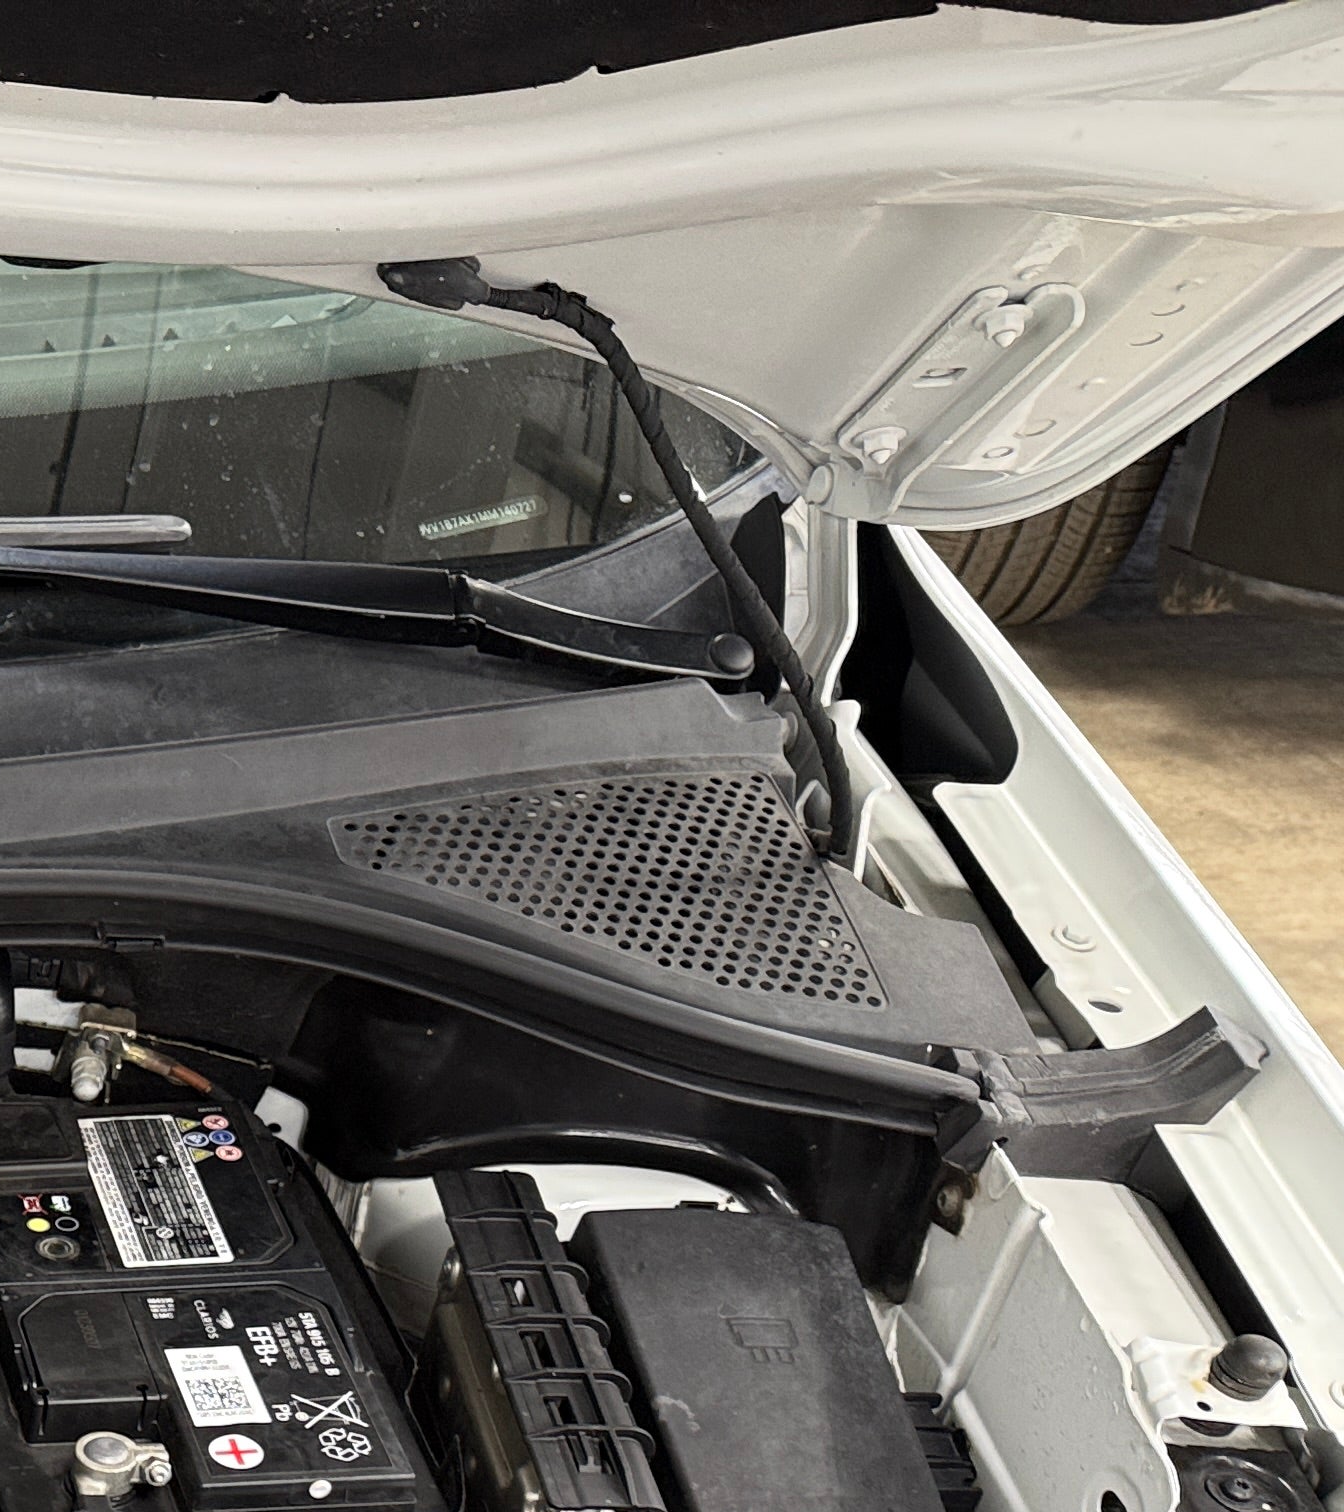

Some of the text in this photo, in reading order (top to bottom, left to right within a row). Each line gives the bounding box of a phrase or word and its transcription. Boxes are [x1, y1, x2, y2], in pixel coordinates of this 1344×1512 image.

[193, 1299, 220, 1341] CLARIOS
[245, 1326, 281, 1367] EFB+
[272, 1403, 294, 1421] Pb
